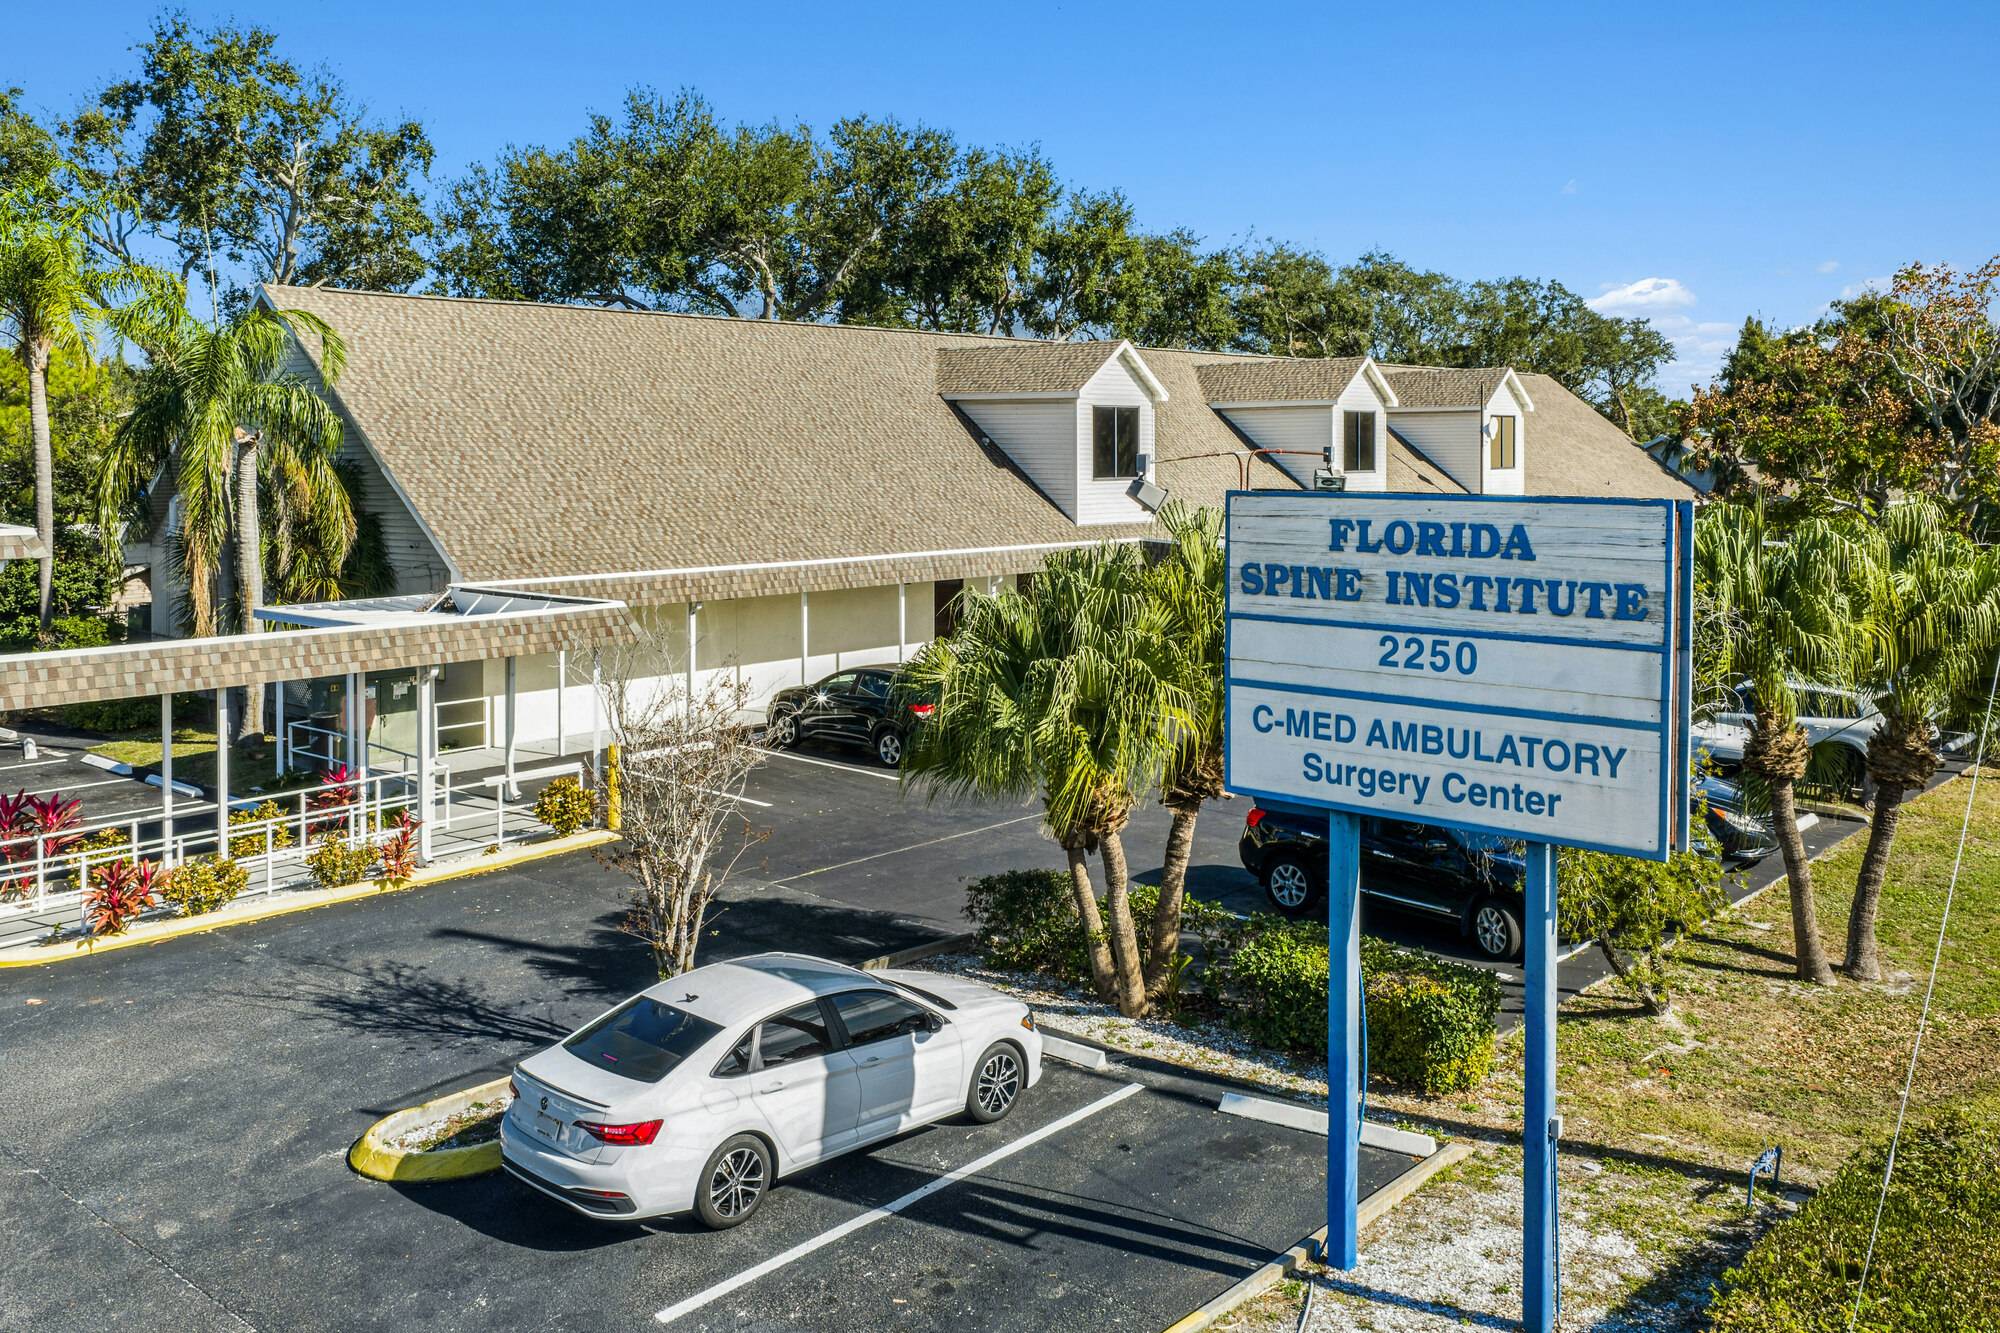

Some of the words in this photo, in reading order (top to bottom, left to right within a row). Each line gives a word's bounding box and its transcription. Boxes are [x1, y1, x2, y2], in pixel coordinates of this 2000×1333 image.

[1328, 518, 1537, 562] FLORIDA
[1240, 562, 1364, 602] SPINE
[1385, 569, 1649, 623] INSTITUTE
[1378, 635, 1479, 676] 2250
[1252, 704, 1357, 744] C-MED
[1366, 718, 1628, 780] AMBULATORY
[1302, 752, 1431, 805] Surgery
[1442, 772, 1562, 818] Center
